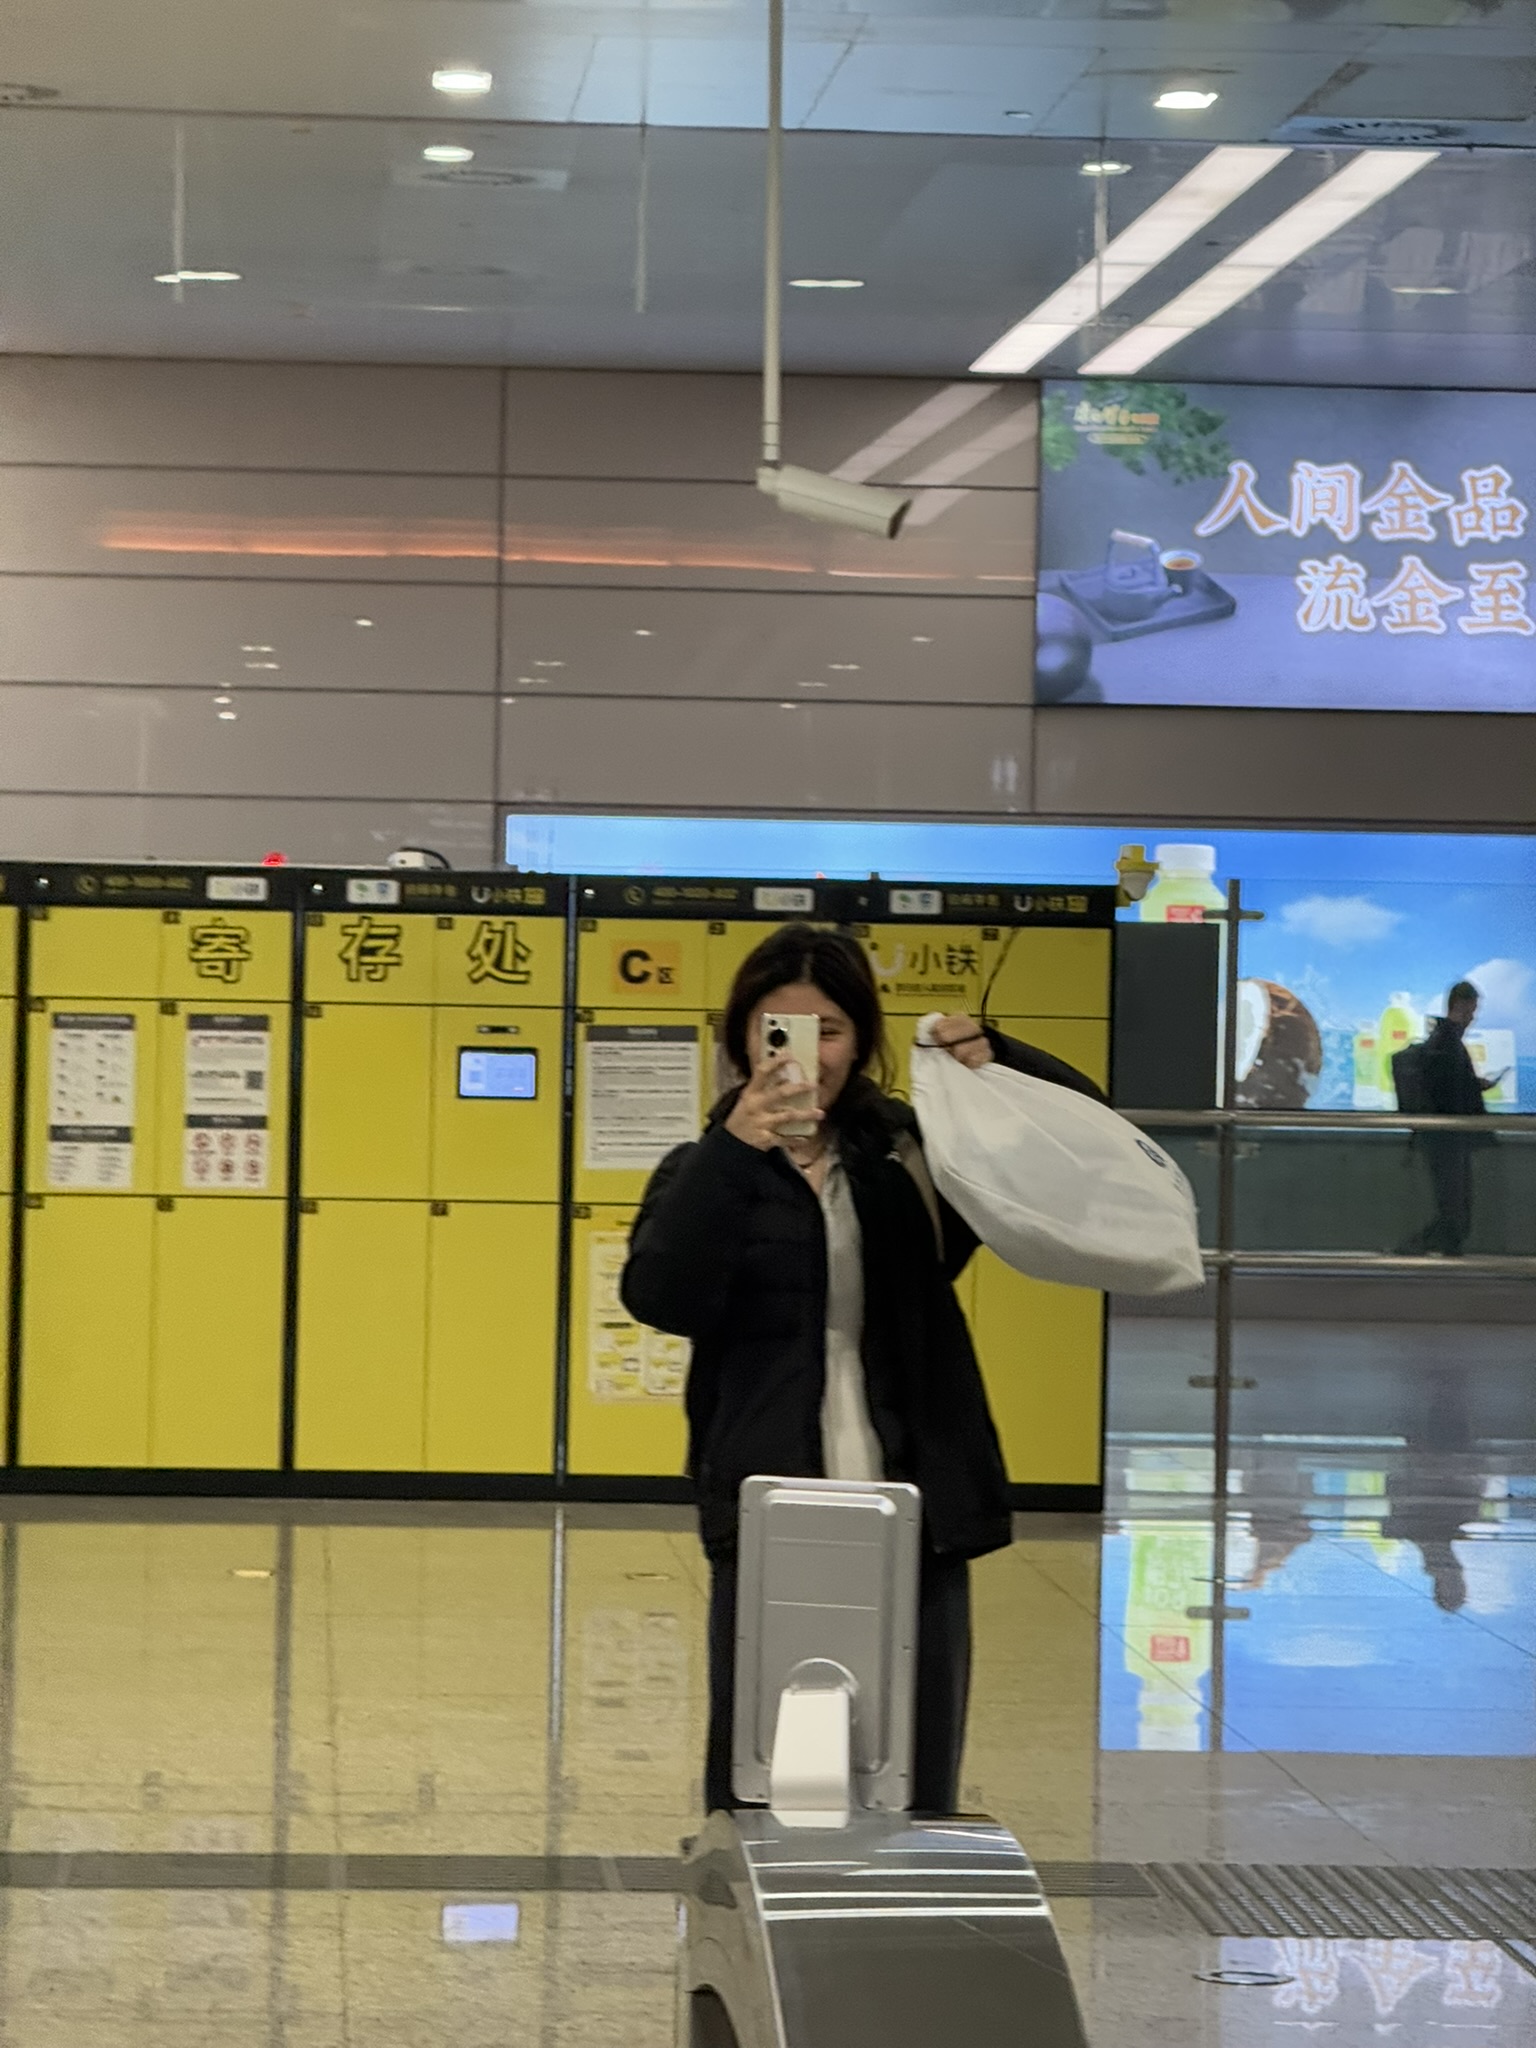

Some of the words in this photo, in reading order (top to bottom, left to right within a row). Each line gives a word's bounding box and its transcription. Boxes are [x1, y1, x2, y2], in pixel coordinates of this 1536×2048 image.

[1195, 459, 1528, 546] 人间金品
[1296, 554, 1535, 635] 流金至
[188, 915, 532, 984] 寄存处
